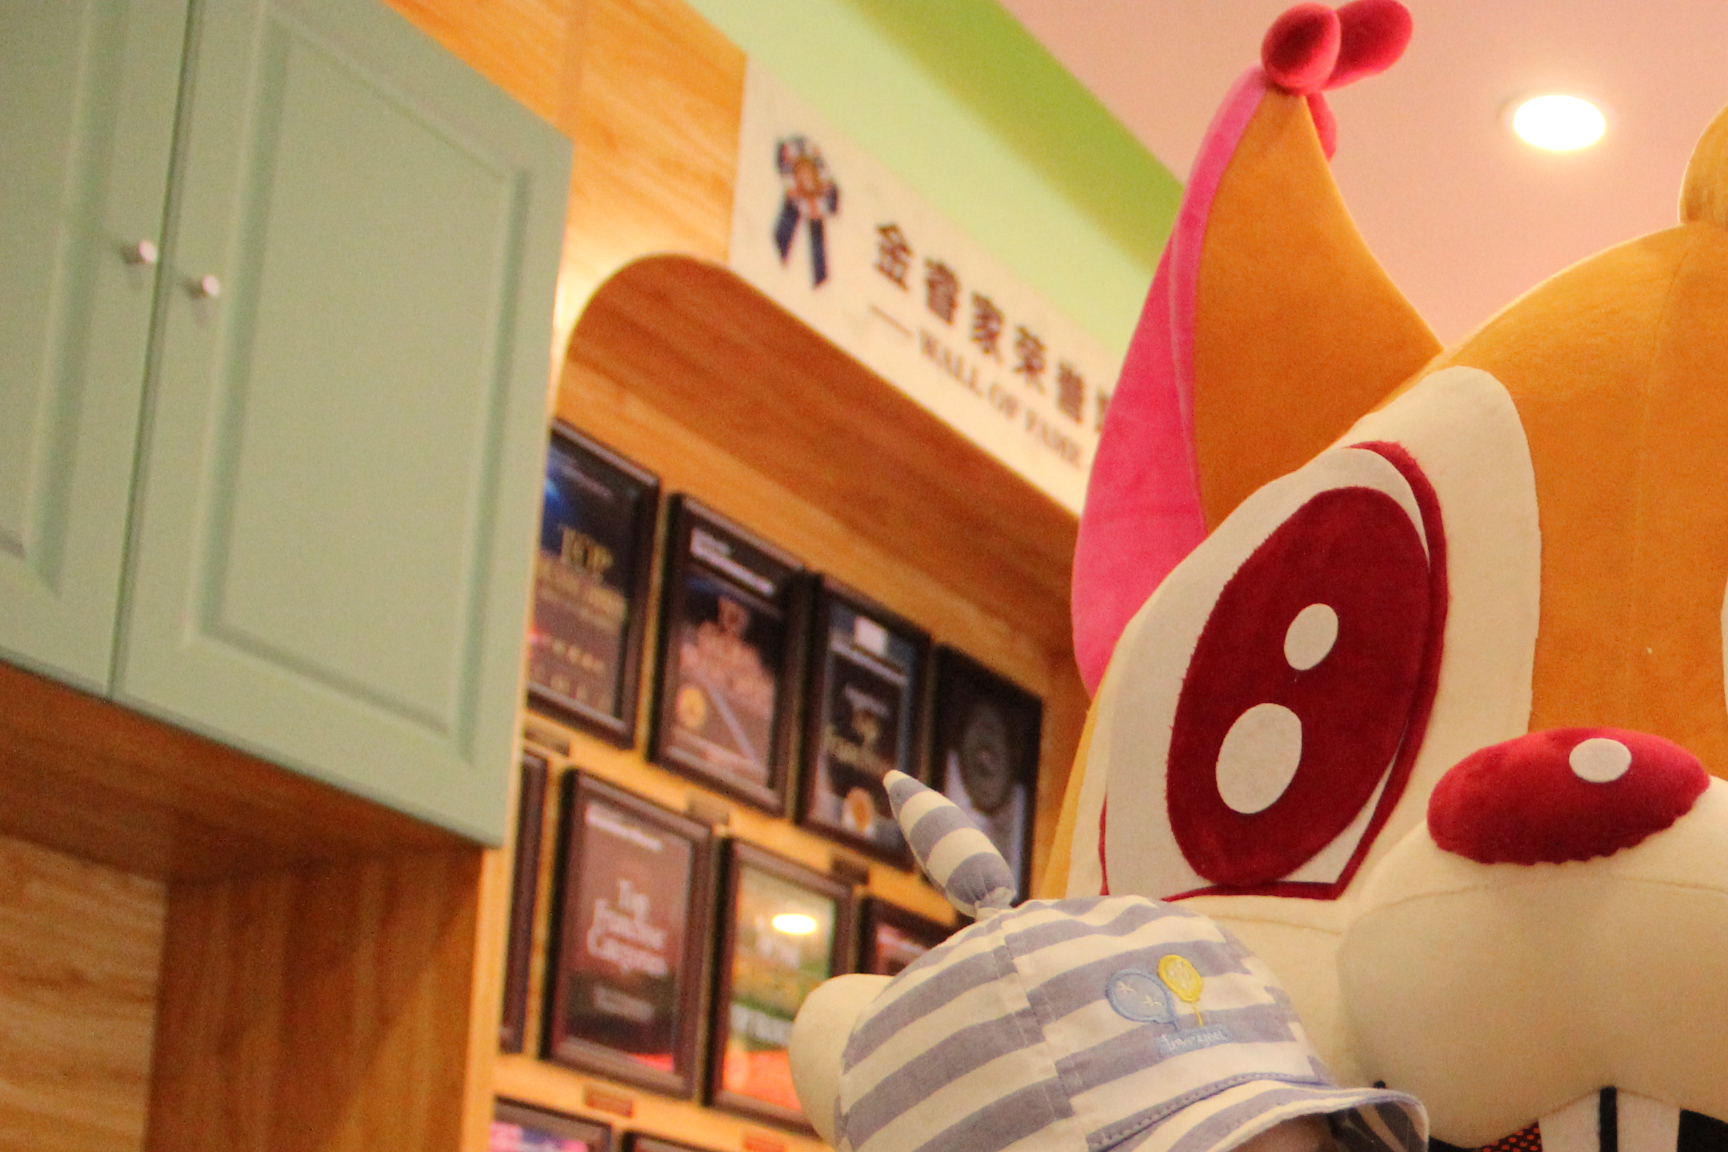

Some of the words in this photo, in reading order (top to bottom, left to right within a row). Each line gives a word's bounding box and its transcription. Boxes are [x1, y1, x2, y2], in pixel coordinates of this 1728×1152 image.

[919, 329, 983, 399] WALL
[988, 382, 1019, 420] OF
[1025, 408, 1082, 470] FAME
